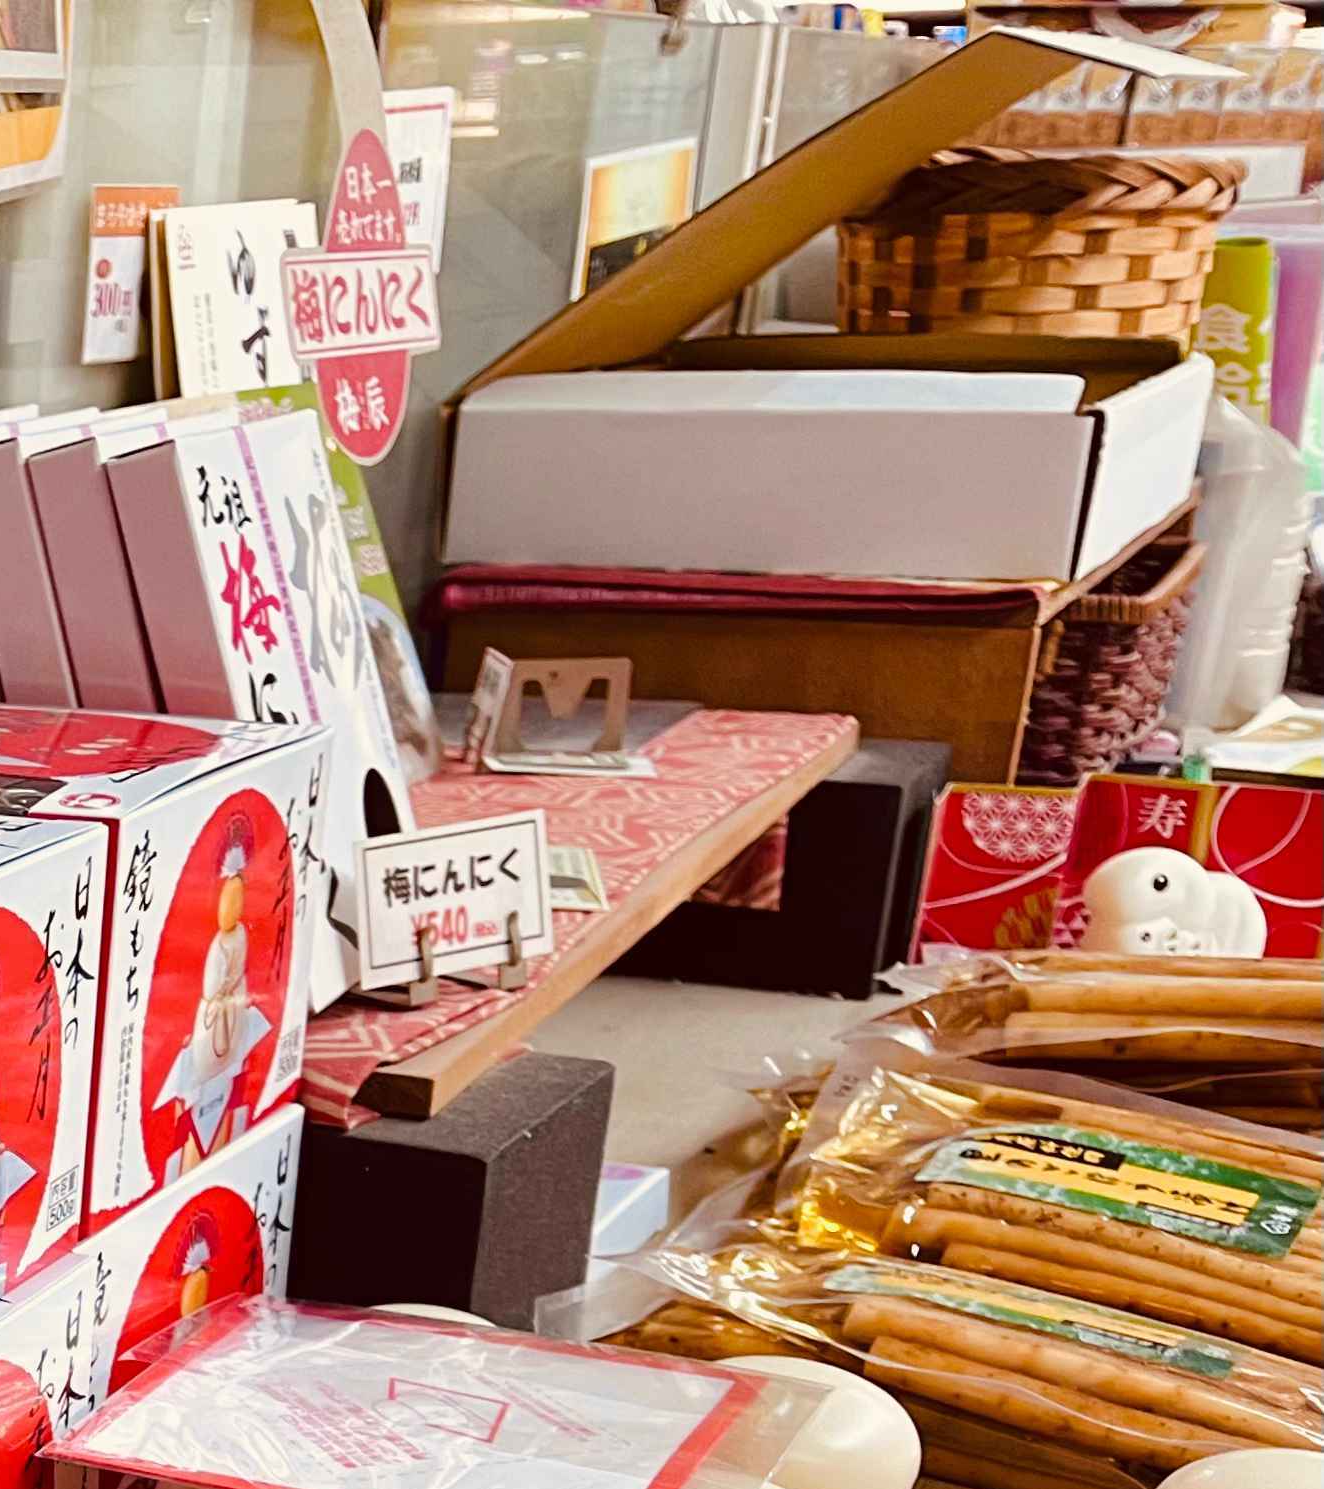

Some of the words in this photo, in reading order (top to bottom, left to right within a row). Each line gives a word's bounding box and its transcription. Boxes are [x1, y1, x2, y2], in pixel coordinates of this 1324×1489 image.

[1136, 793, 1187, 840] 寿
[382, 848, 521, 908] 梅にんにく
[48, 1197, 76, 1227] 500g
